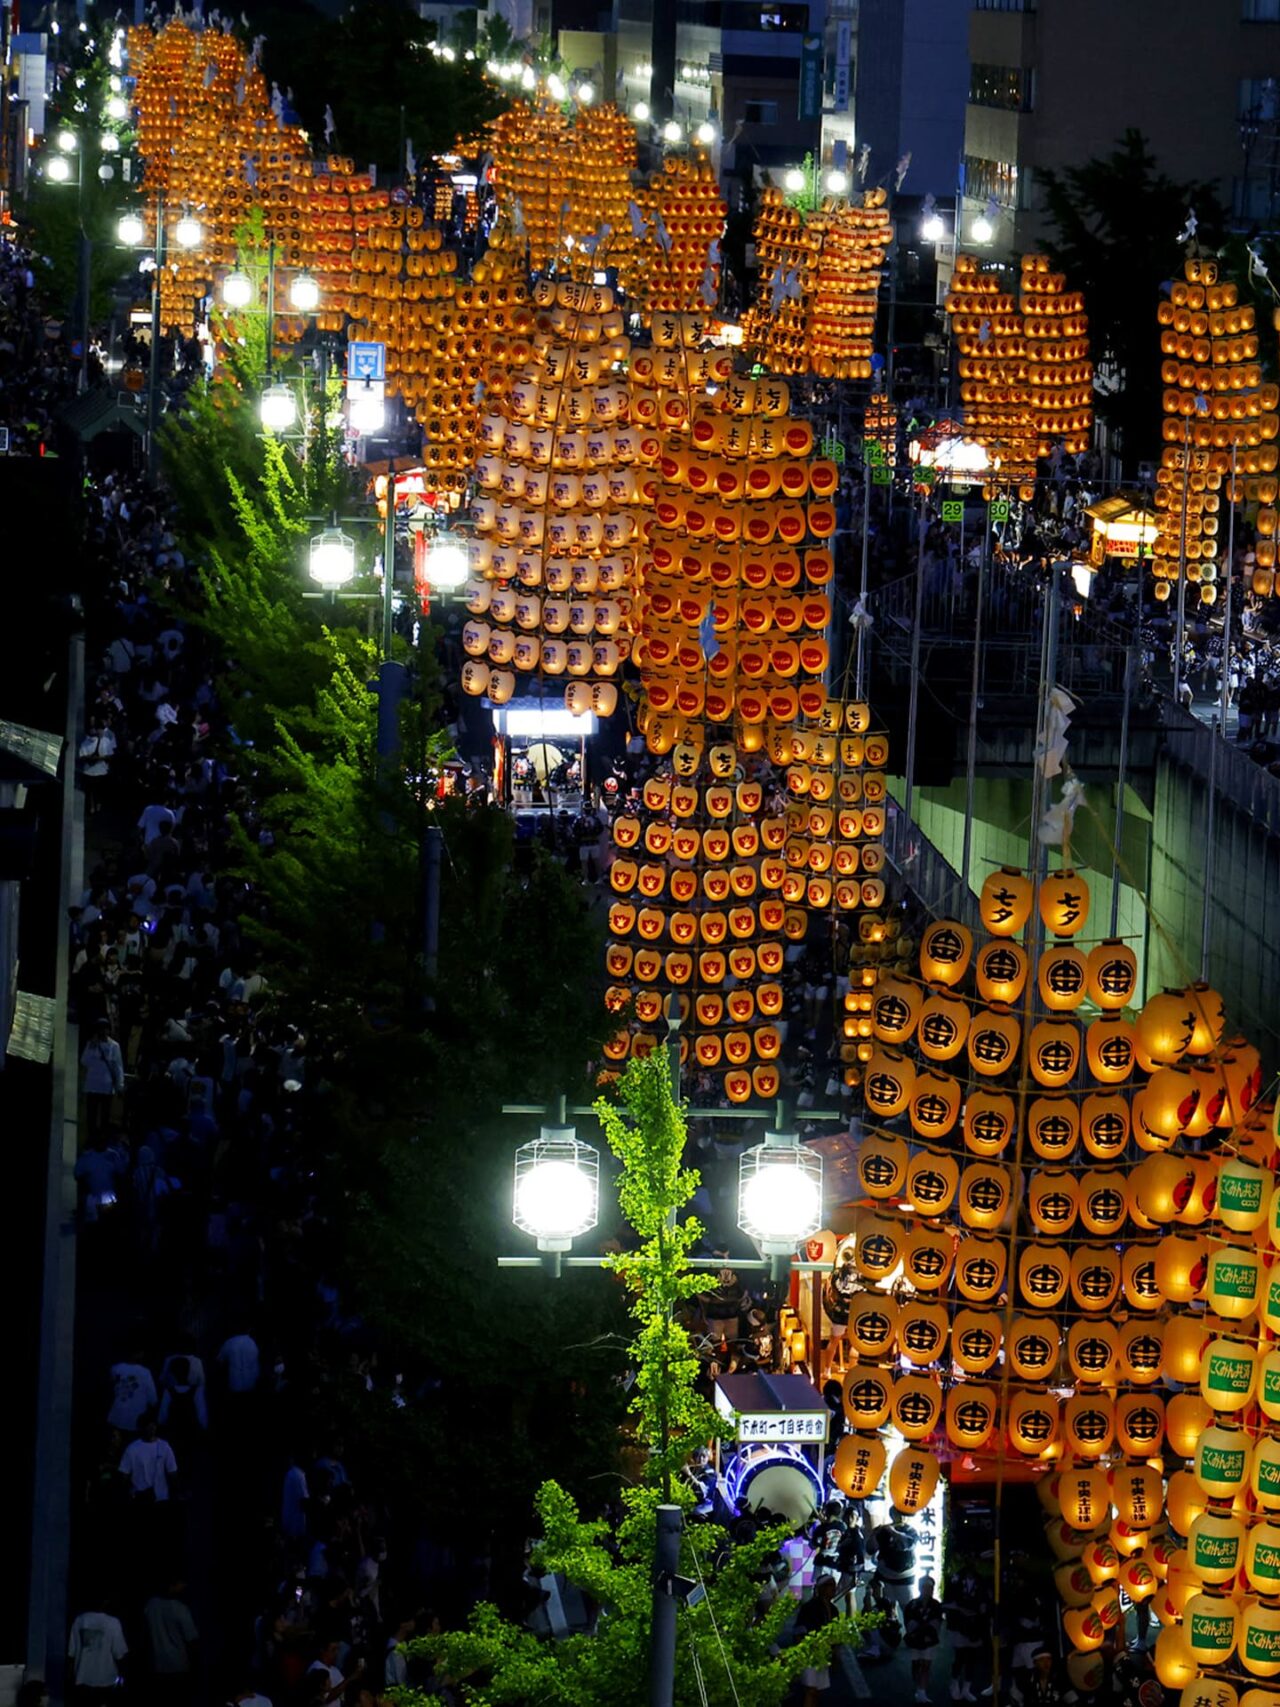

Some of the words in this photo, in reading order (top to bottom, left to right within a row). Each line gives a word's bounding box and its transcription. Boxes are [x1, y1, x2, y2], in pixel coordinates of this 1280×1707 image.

[663, 320, 674, 340] 七夕
[691, 322, 703, 341] 七夕
[546, 356, 557, 376] 七夕
[576, 360, 588, 379] 七夕
[732, 387, 745, 408] 七夕
[767, 389, 780, 409] 七夕
[944, 503, 961, 515] 29
[991, 503, 1007, 516] 30
[990, 888, 1017, 923] 七夕
[1057, 893, 1081, 925] 七夕
